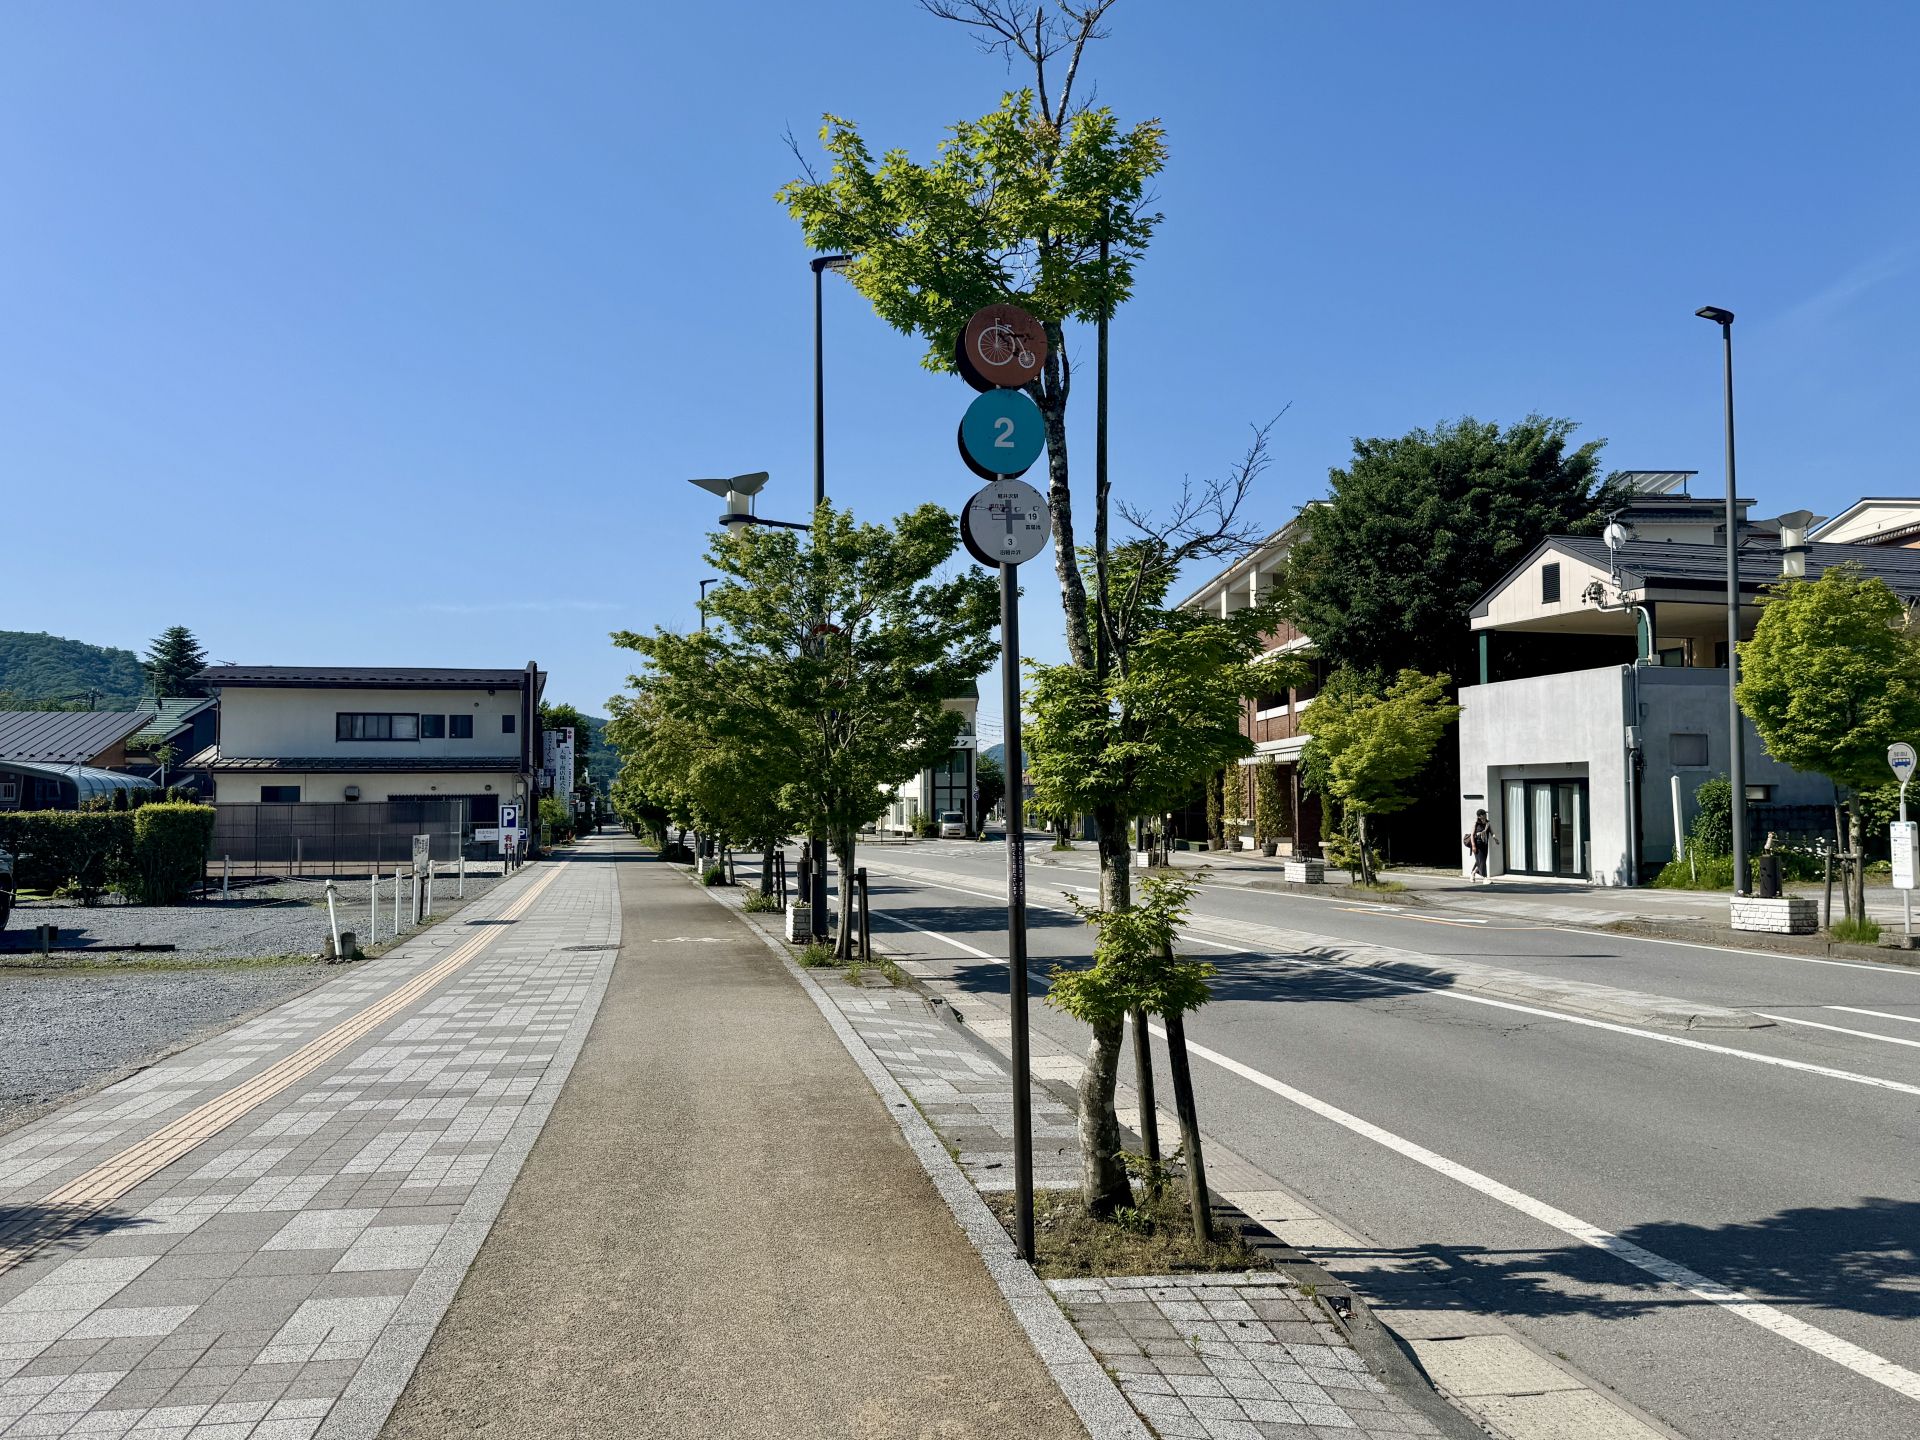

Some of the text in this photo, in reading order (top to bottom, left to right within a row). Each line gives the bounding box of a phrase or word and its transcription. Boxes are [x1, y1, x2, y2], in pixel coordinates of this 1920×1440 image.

[994, 417, 1014, 448] 2
[503, 808, 515, 826] P
[518, 829, 525, 838] P
